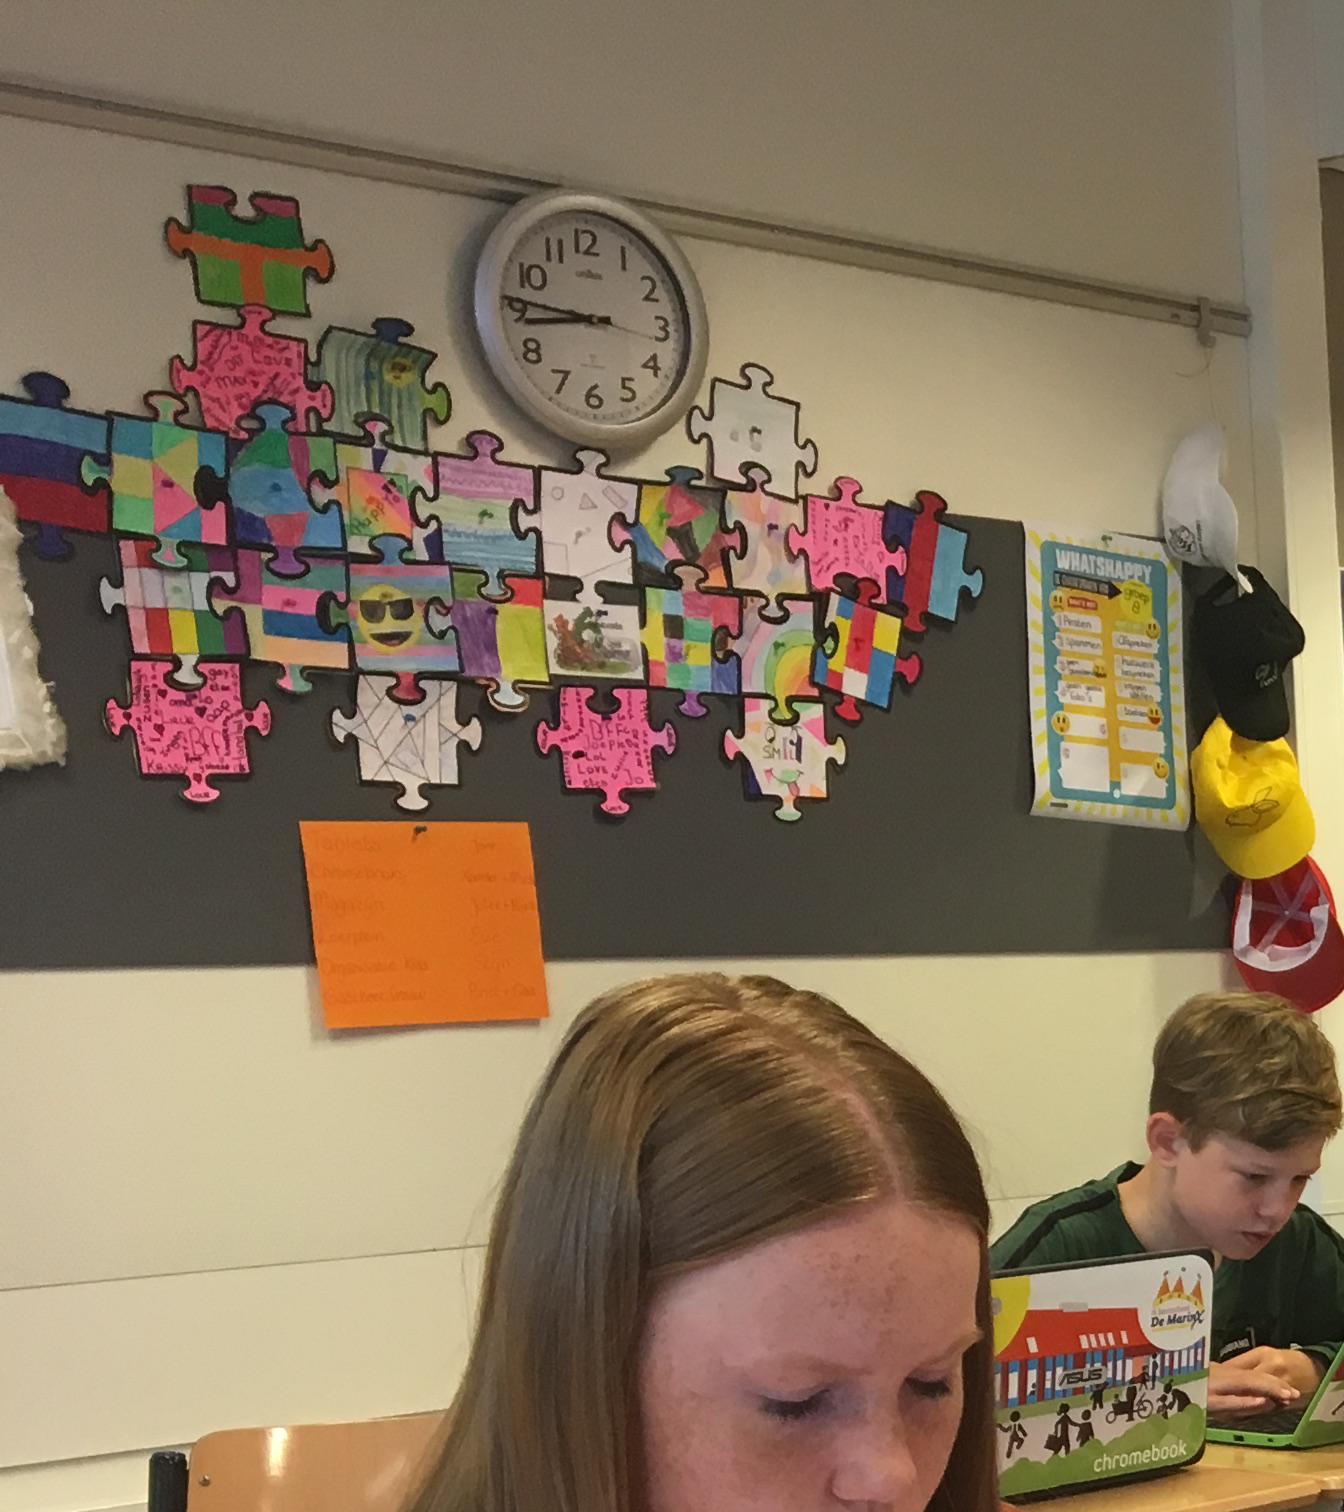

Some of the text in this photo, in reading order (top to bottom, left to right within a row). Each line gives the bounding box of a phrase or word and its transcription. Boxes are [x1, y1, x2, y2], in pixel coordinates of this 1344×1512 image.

[545, 236, 564, 264] 11
[573, 228, 600, 257] 12
[620, 245, 627, 272] 1
[518, 262, 548, 291] 10
[640, 275, 660, 303] 2
[506, 298, 528, 323] 9
[654, 315, 670, 343] 3
[522, 337, 543, 365] 8
[641, 352, 662, 378] 4
[550, 368, 572, 395] 7
[619, 376, 637, 403] 5
[584, 383, 605, 410] 6
[1055, 548, 1152, 584] WHATSHAPPY
[1150, 1315, 1165, 1329] De
[1058, 1366, 1105, 1387] ASUS
[1093, 1439, 1188, 1474] chromebook
